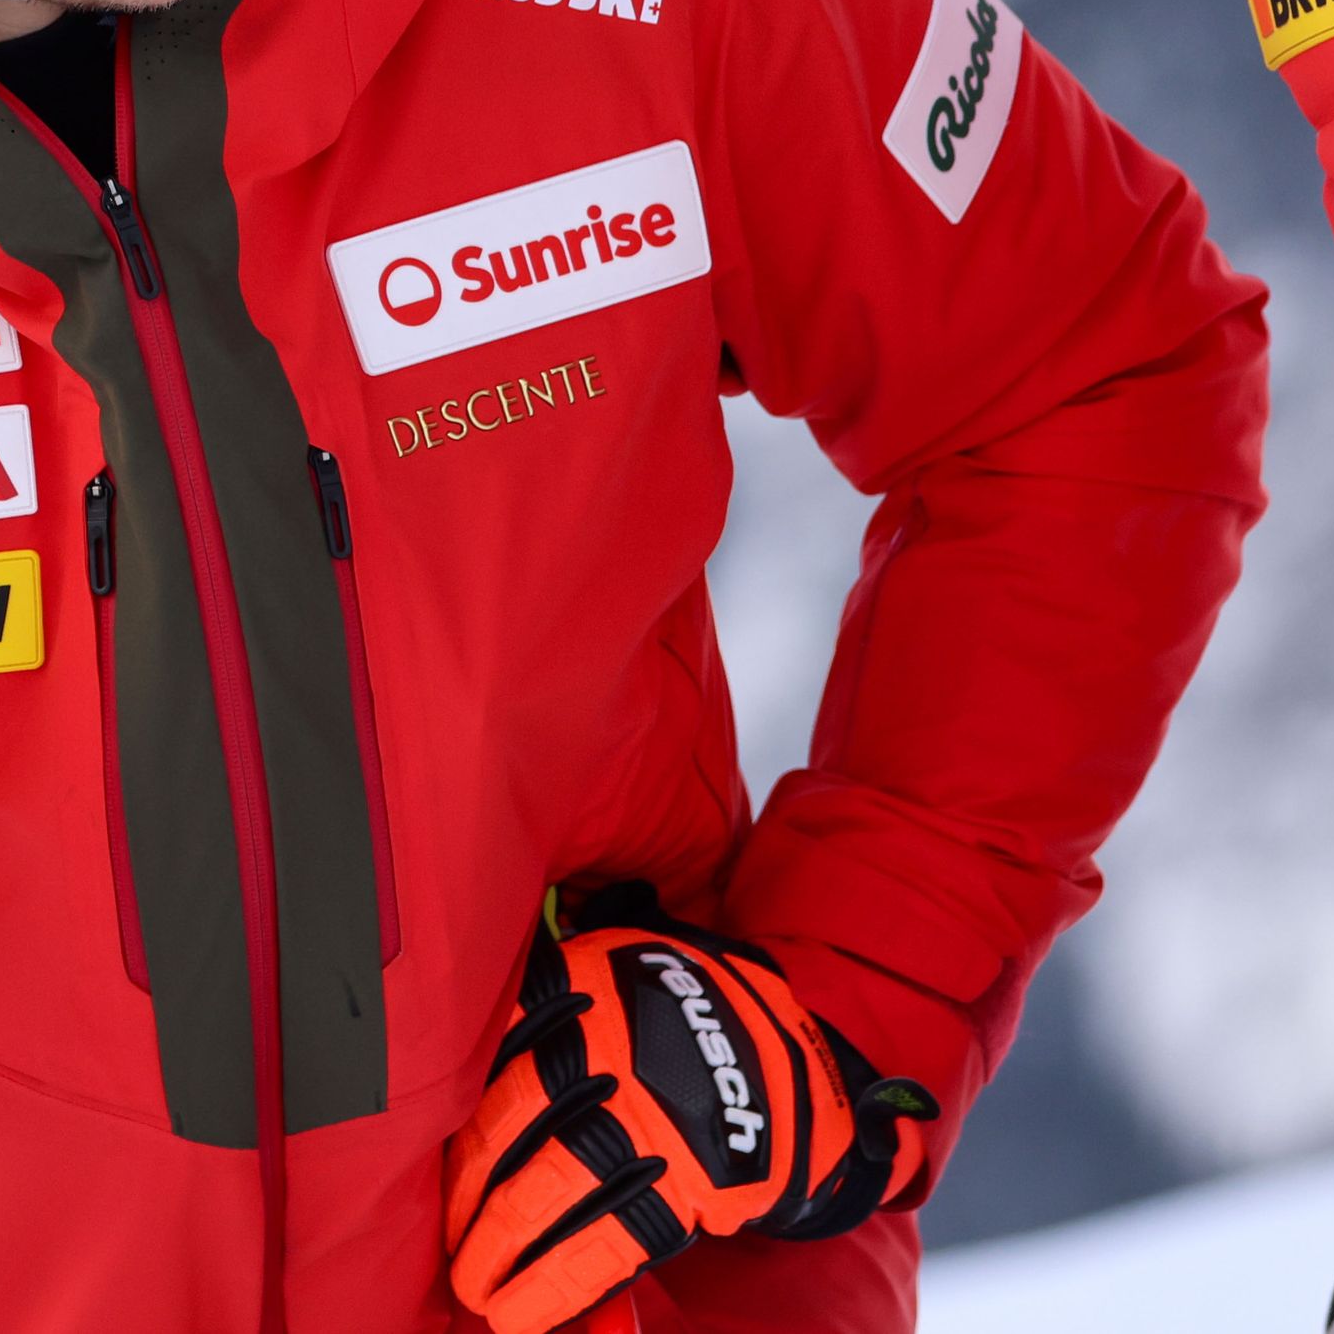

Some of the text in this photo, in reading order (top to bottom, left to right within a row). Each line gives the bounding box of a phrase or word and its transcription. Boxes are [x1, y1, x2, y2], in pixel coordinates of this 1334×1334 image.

[451, 202, 677, 304] Sunrise
[386, 356, 607, 459] DESCENTE
[639, 950, 765, 1154] reusch
